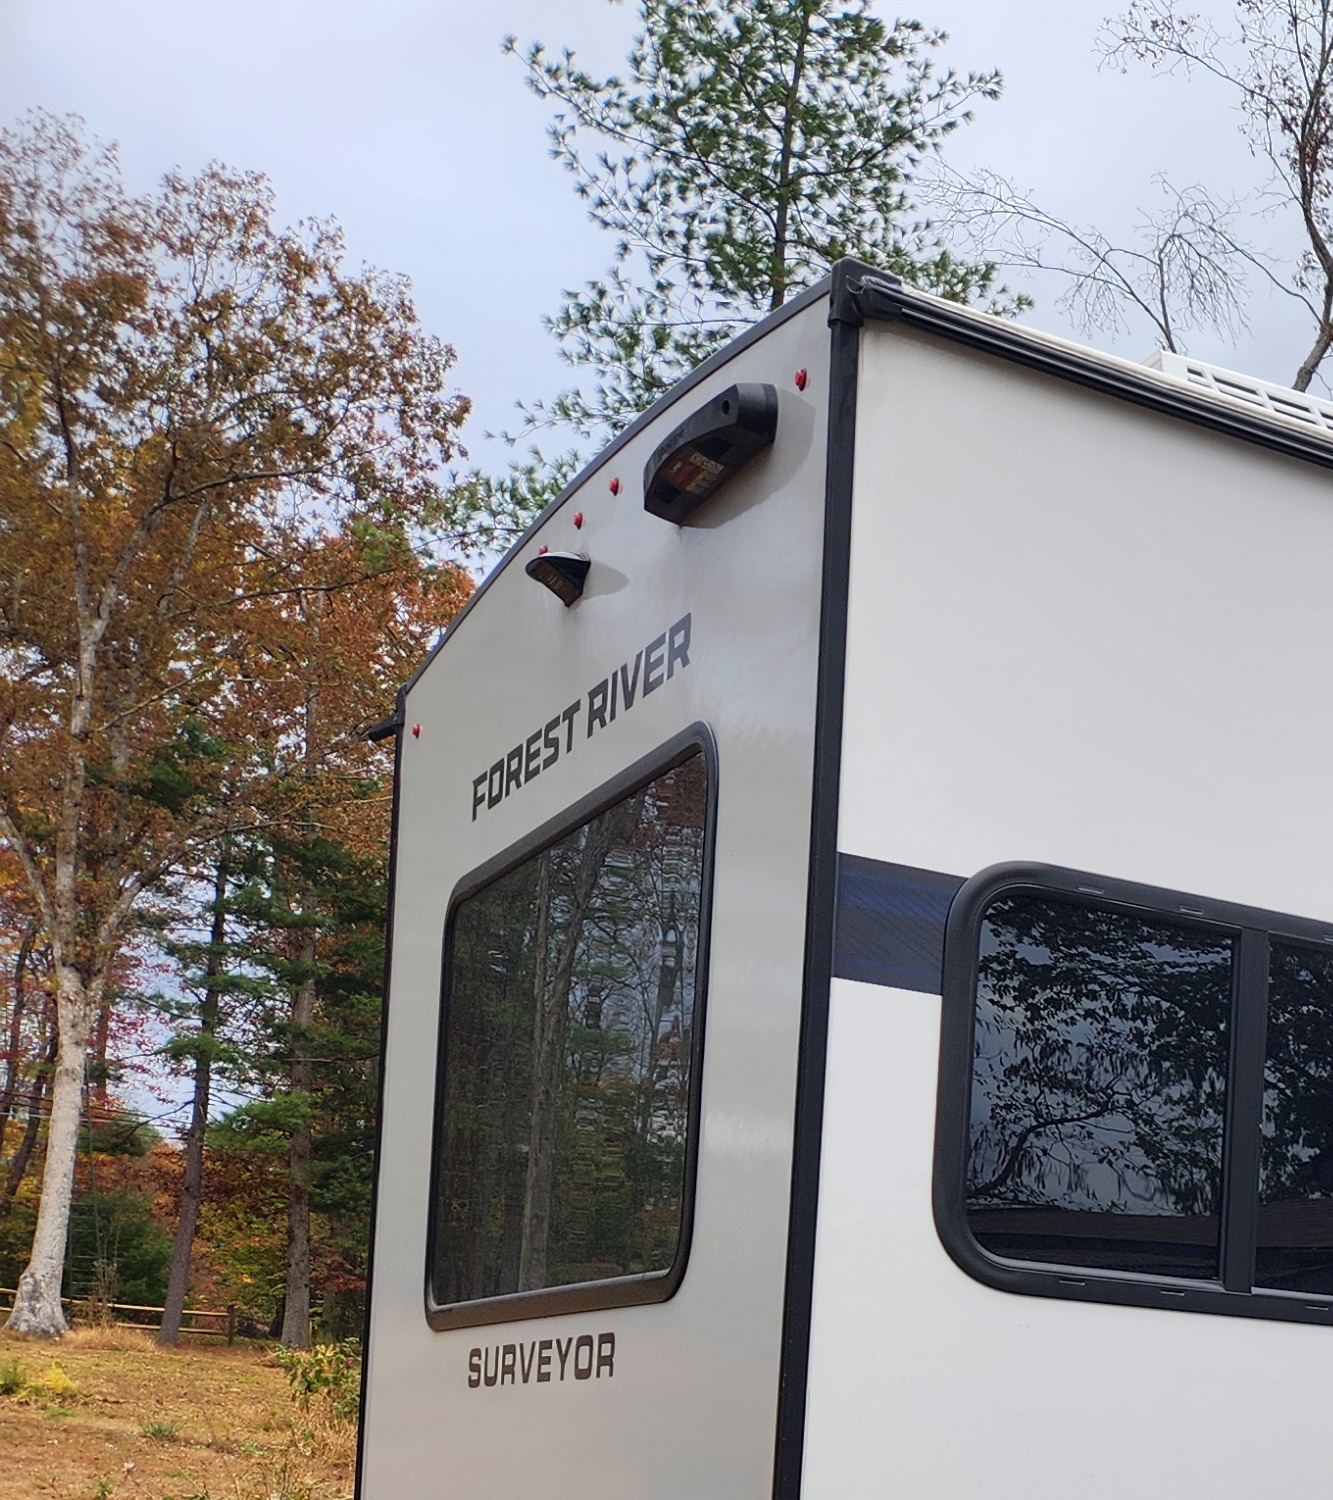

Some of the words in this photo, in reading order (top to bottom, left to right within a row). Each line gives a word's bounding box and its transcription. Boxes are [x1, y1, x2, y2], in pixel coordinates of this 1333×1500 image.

[472, 698, 582, 823] FOREST
[587, 612, 692, 740] RIVER
[467, 1332, 616, 1389] SURVEYOR
